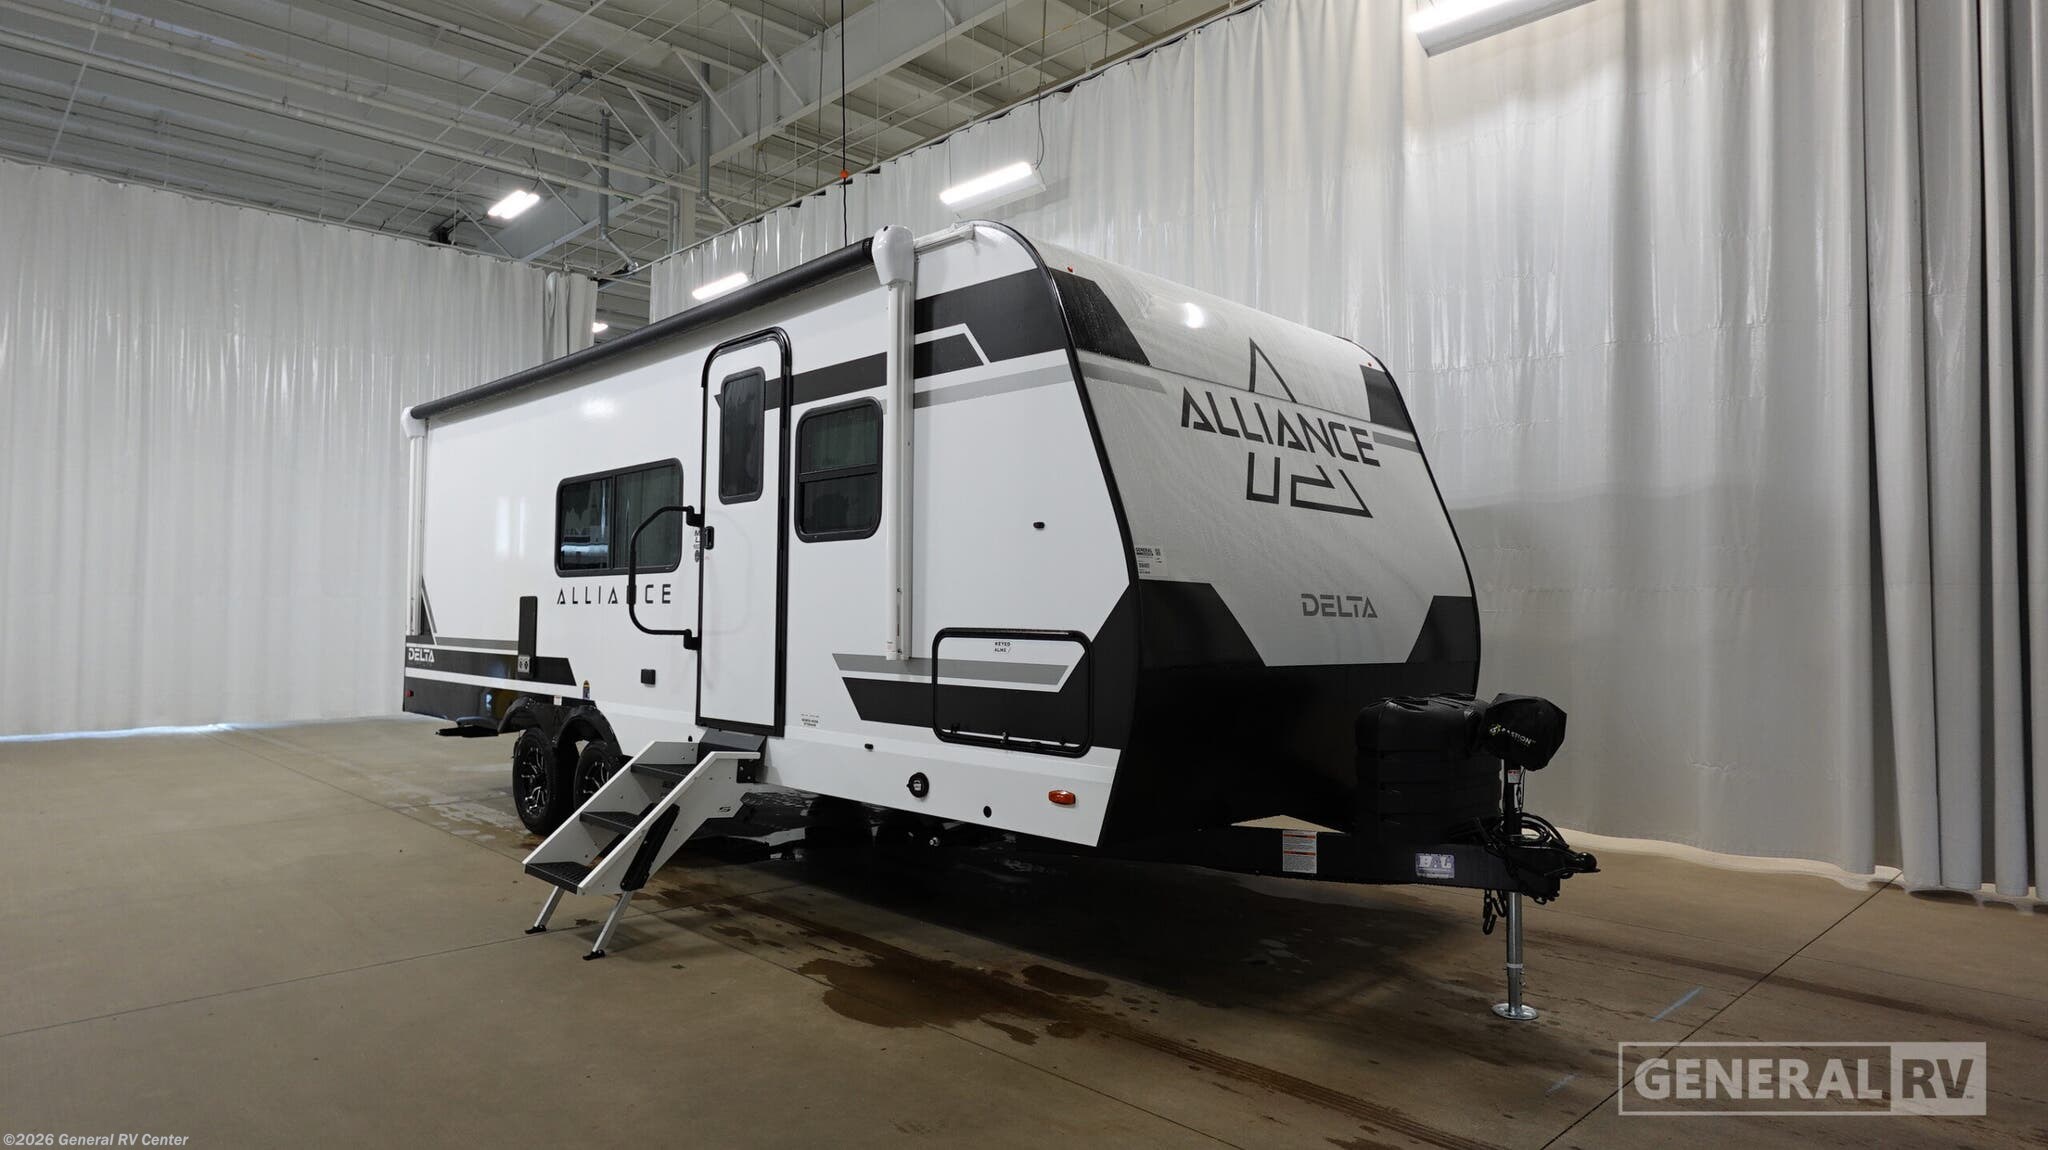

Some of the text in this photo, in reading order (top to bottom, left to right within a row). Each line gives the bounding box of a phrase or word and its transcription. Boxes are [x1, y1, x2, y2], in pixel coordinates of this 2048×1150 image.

[1181, 386, 1381, 468] ALLIANCE
[557, 584, 671, 605] ALLIACE
[1301, 593, 1378, 618] DELTA
[408, 647, 435, 663] DELTA
